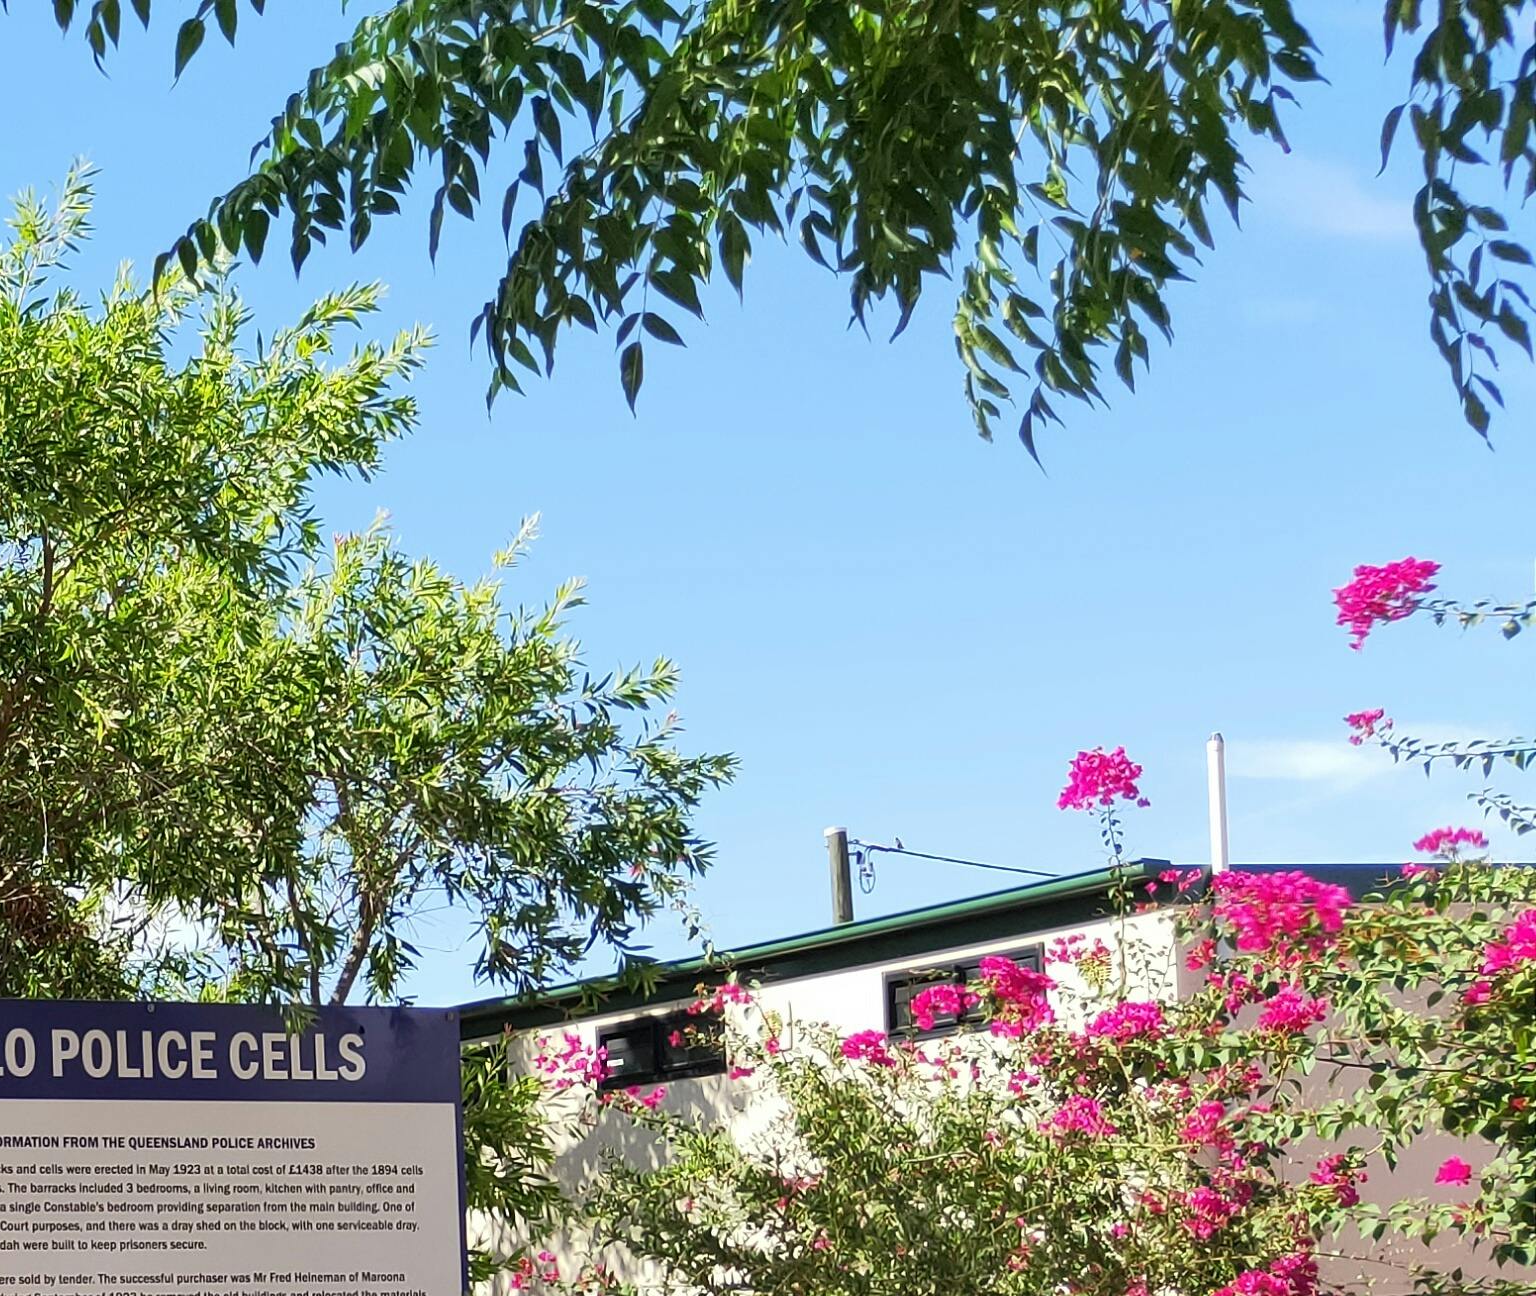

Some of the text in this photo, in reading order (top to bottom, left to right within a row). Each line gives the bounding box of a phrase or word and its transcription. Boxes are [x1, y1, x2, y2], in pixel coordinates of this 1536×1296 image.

[51, 1028, 218, 1080] POLICE
[229, 1030, 367, 1082] CELLS
[62, 1136, 99, 1148] FROM
[101, 1136, 125, 1148] THE
[127, 1136, 208, 1149] QUEENSLAND
[211, 1137, 254, 1148] POLICE
[256, 1137, 315, 1149] ARCHIVES
[15, 1163, 36, 1174] and
[38, 1163, 63, 1174] cells
[65, 1166, 91, 1174] were
[93, 1164, 133, 1174] erected
[135, 1163, 146, 1174] in
[148, 1163, 170, 1177] May
[172, 1163, 201, 1174] 1923
[203, 1164, 214, 1175] at
[216, 1166, 224, 1174] a
[226, 1164, 249, 1174] total
[251, 1165, 273, 1175] cost
[275, 1164, 286, 1175] of
[287, 1164, 323, 1175] £1438
[325, 1164, 349, 1175] after
[351, 1164, 368, 1175] the
[371, 1164, 398, 1175] 1894
[400, 1164, 423, 1175] cells
[6, 1182, 27, 1193] The
[29, 1182, 76, 1193] barracks
[78, 1182, 123, 1193] included
[125, 1182, 133, 1193] 3
[135, 1183, 191, 1194] bedrooms,
[193, 1184, 200, 1193] a
[202, 1182, 231, 1195] living
[232, 1185, 262, 1194] room,
[264, 1182, 302, 1193] kitchen
[304, 1182, 326, 1193] with
[328, 1184, 363, 1195] pantry,
[365, 1183, 393, 1193] office
[395, 1183, 414, 1193] and
[22, 1241, 48, 1250] were
[51, 1239, 75, 1250] built
[77, 1239, 88, 1250] to
[90, 1239, 117, 1251] keep
[119, 1239, 168, 1251] prisoners
[169, 1240, 207, 1249] secure.
